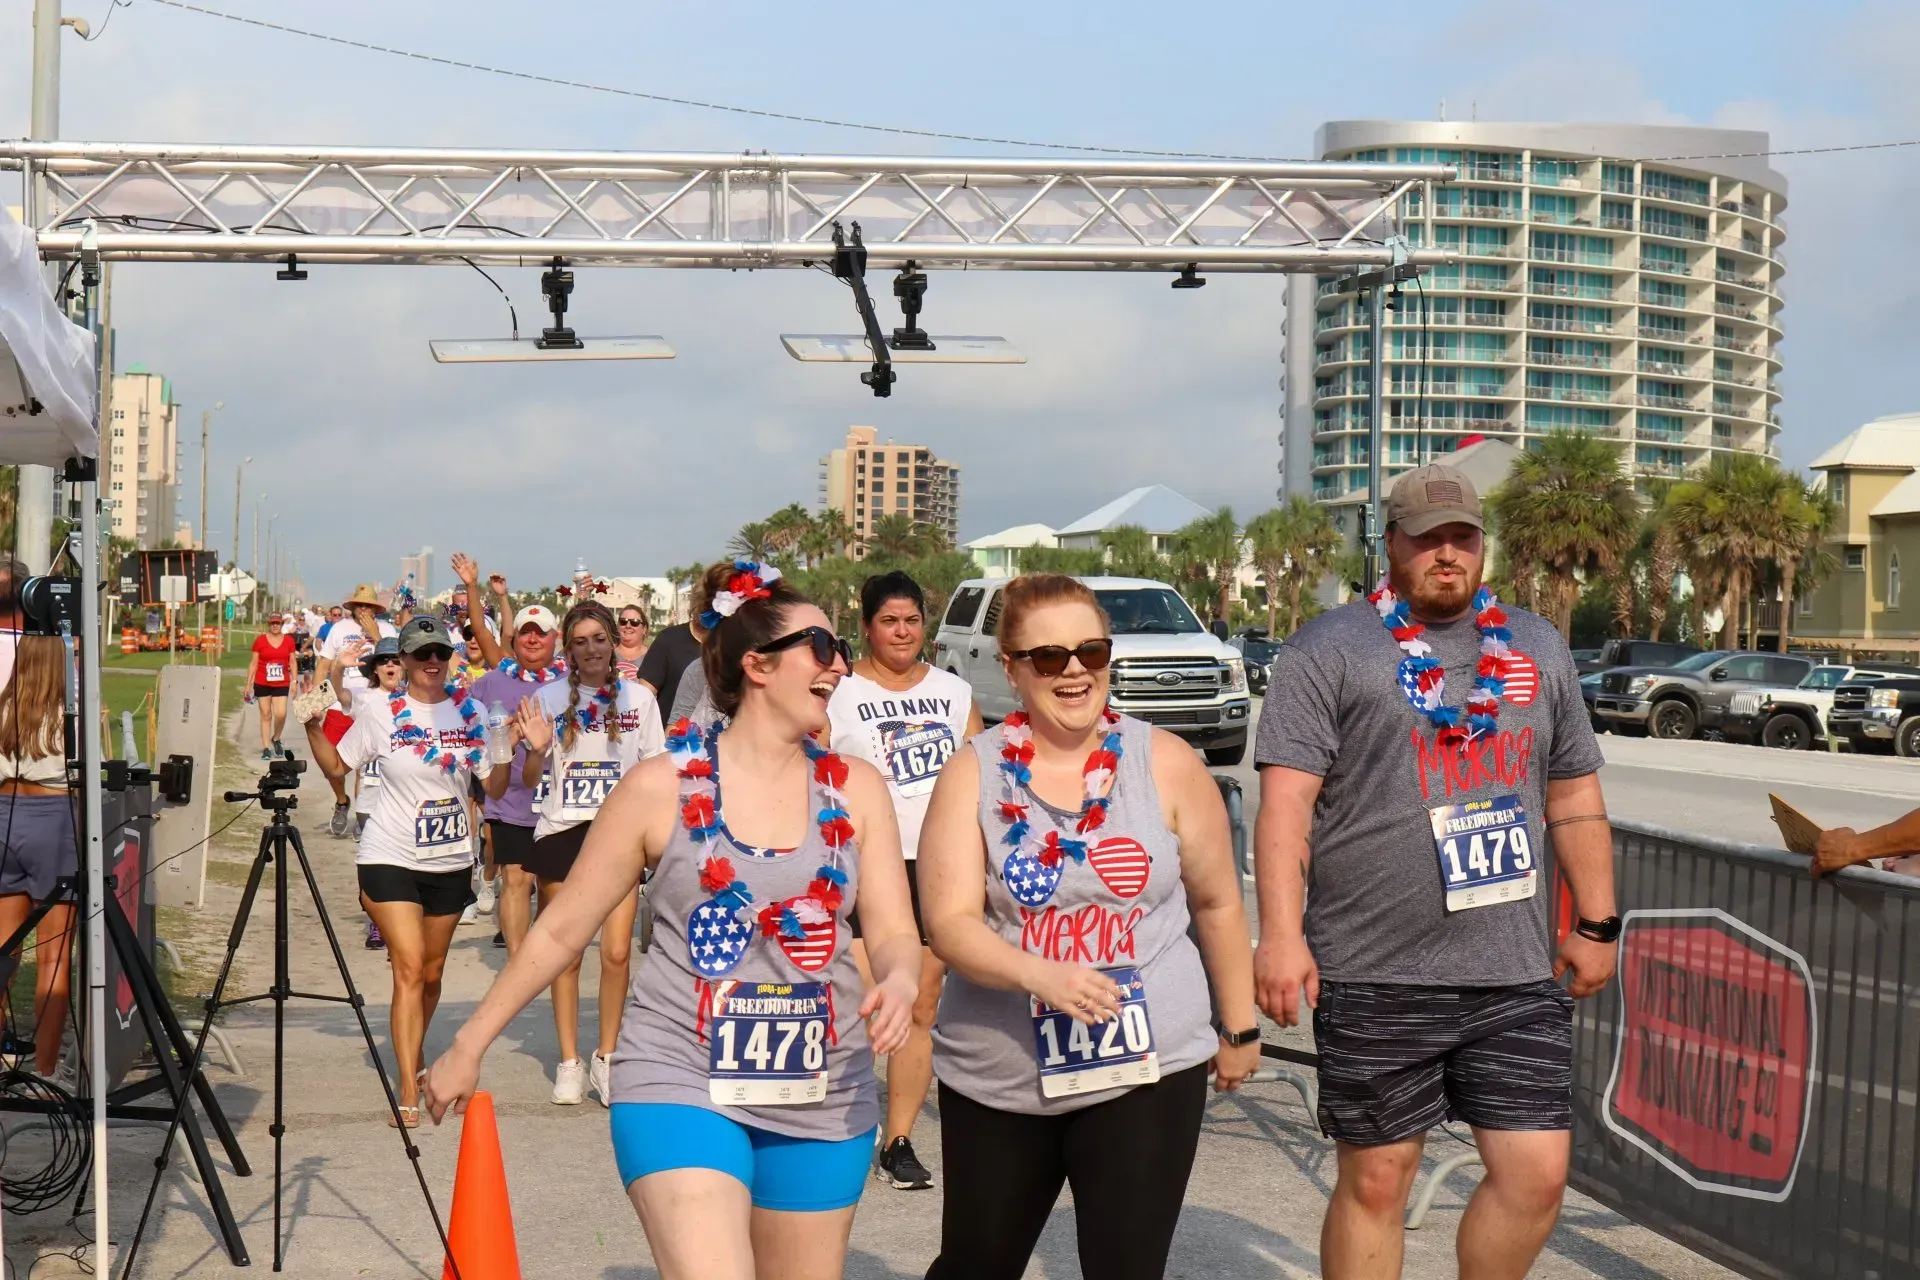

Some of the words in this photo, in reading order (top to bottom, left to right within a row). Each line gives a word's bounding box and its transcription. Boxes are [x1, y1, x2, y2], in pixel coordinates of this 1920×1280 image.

[857, 700, 898, 722] OLD
[900, 699, 951, 717] NAVY
[892, 738, 955, 781] 1628
[417, 812, 468, 843] 1248
[1446, 812, 1495, 833] FREEDOM
[1443, 826, 1531, 883] 1479
[728, 997, 791, 1015] FREEDOM
[791, 998, 817, 1014] RUN
[757, 983, 793, 995] FLORA-BAMA
[1637, 956, 1786, 1059] INTERNATIONAL
[716, 1020, 825, 1071] 1478
[1040, 1004, 1150, 1066] 1420
[1637, 1025, 1749, 1142] RUNNING
